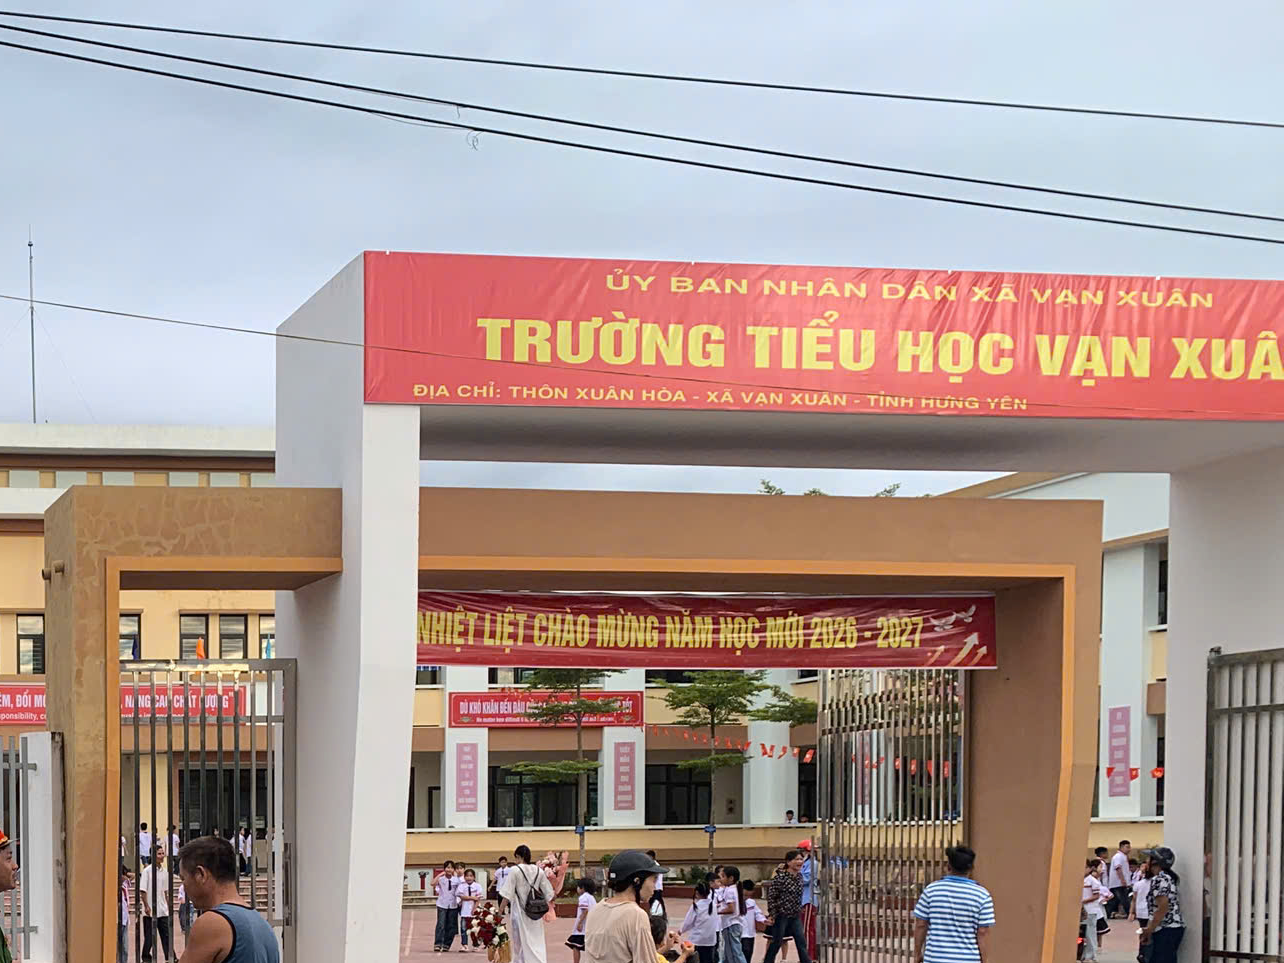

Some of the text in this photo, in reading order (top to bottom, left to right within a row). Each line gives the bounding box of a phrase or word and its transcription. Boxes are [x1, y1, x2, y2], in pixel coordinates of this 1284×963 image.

[606, 268, 1213, 308] ỦY BAN NHÂN DÂN XÃ VẠN XUÂN
[477, 310, 1284, 386] TRƯỜNG TIỂU HỌC VẠN XUÂ
[412, 384, 450, 399] ĐỊA
[457, 381, 501, 398] CHỈ:
[508, 384, 568, 399] THÔN
[575, 386, 634, 402] XUÂN
[642, 387, 686, 402] HÒA
[707, 389, 735, 404] XÃ
[741, 391, 784, 407] VẠN
[790, 388, 847, 406] XUÂN
[867, 390, 914, 408] TỈNH
[921, 395, 980, 409] HƯNG
[987, 395, 1028, 410] YÊN
[417, 605, 479, 653] NHIỆT
[483, 606, 527, 653] LIỆT
[533, 608, 589, 647] CHÀO
[596, 608, 659, 648] MỪNG
[665, 608, 714, 648] NĂM
[719, 616, 760, 656] HỌC
[765, 611, 804, 648] MỚI
[811, 616, 858, 648] 2026
[876, 616, 924, 648] 2027
[16, 689, 32, 708] ĐỔI
